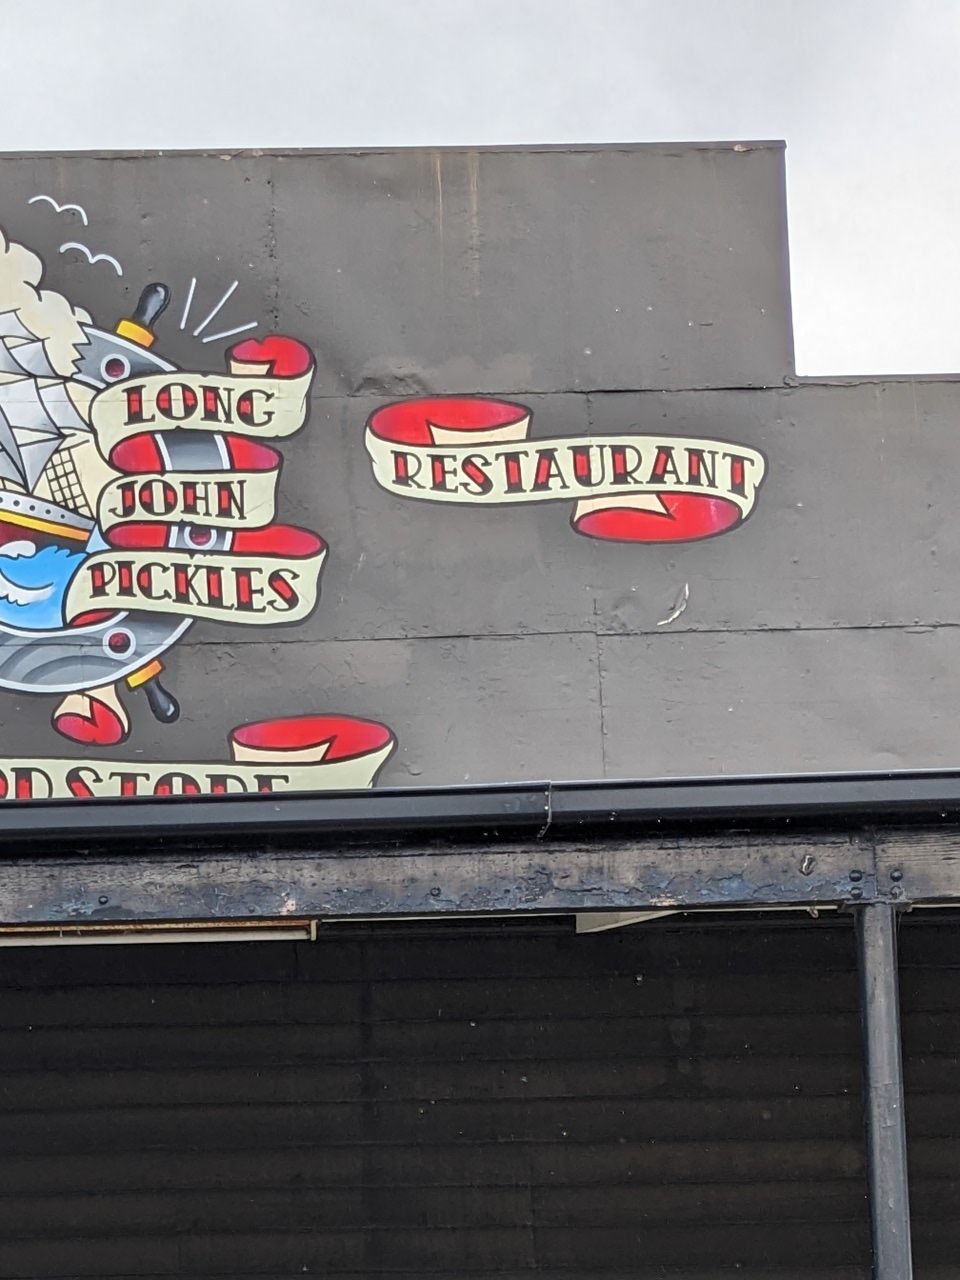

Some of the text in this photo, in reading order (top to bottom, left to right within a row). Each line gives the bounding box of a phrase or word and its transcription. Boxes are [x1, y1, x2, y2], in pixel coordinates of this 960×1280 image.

[122, 382, 276, 426] LONG
[390, 444, 756, 499] RESTAURANT
[108, 478, 248, 521] JOHN
[86, 560, 301, 613] PICKLES
